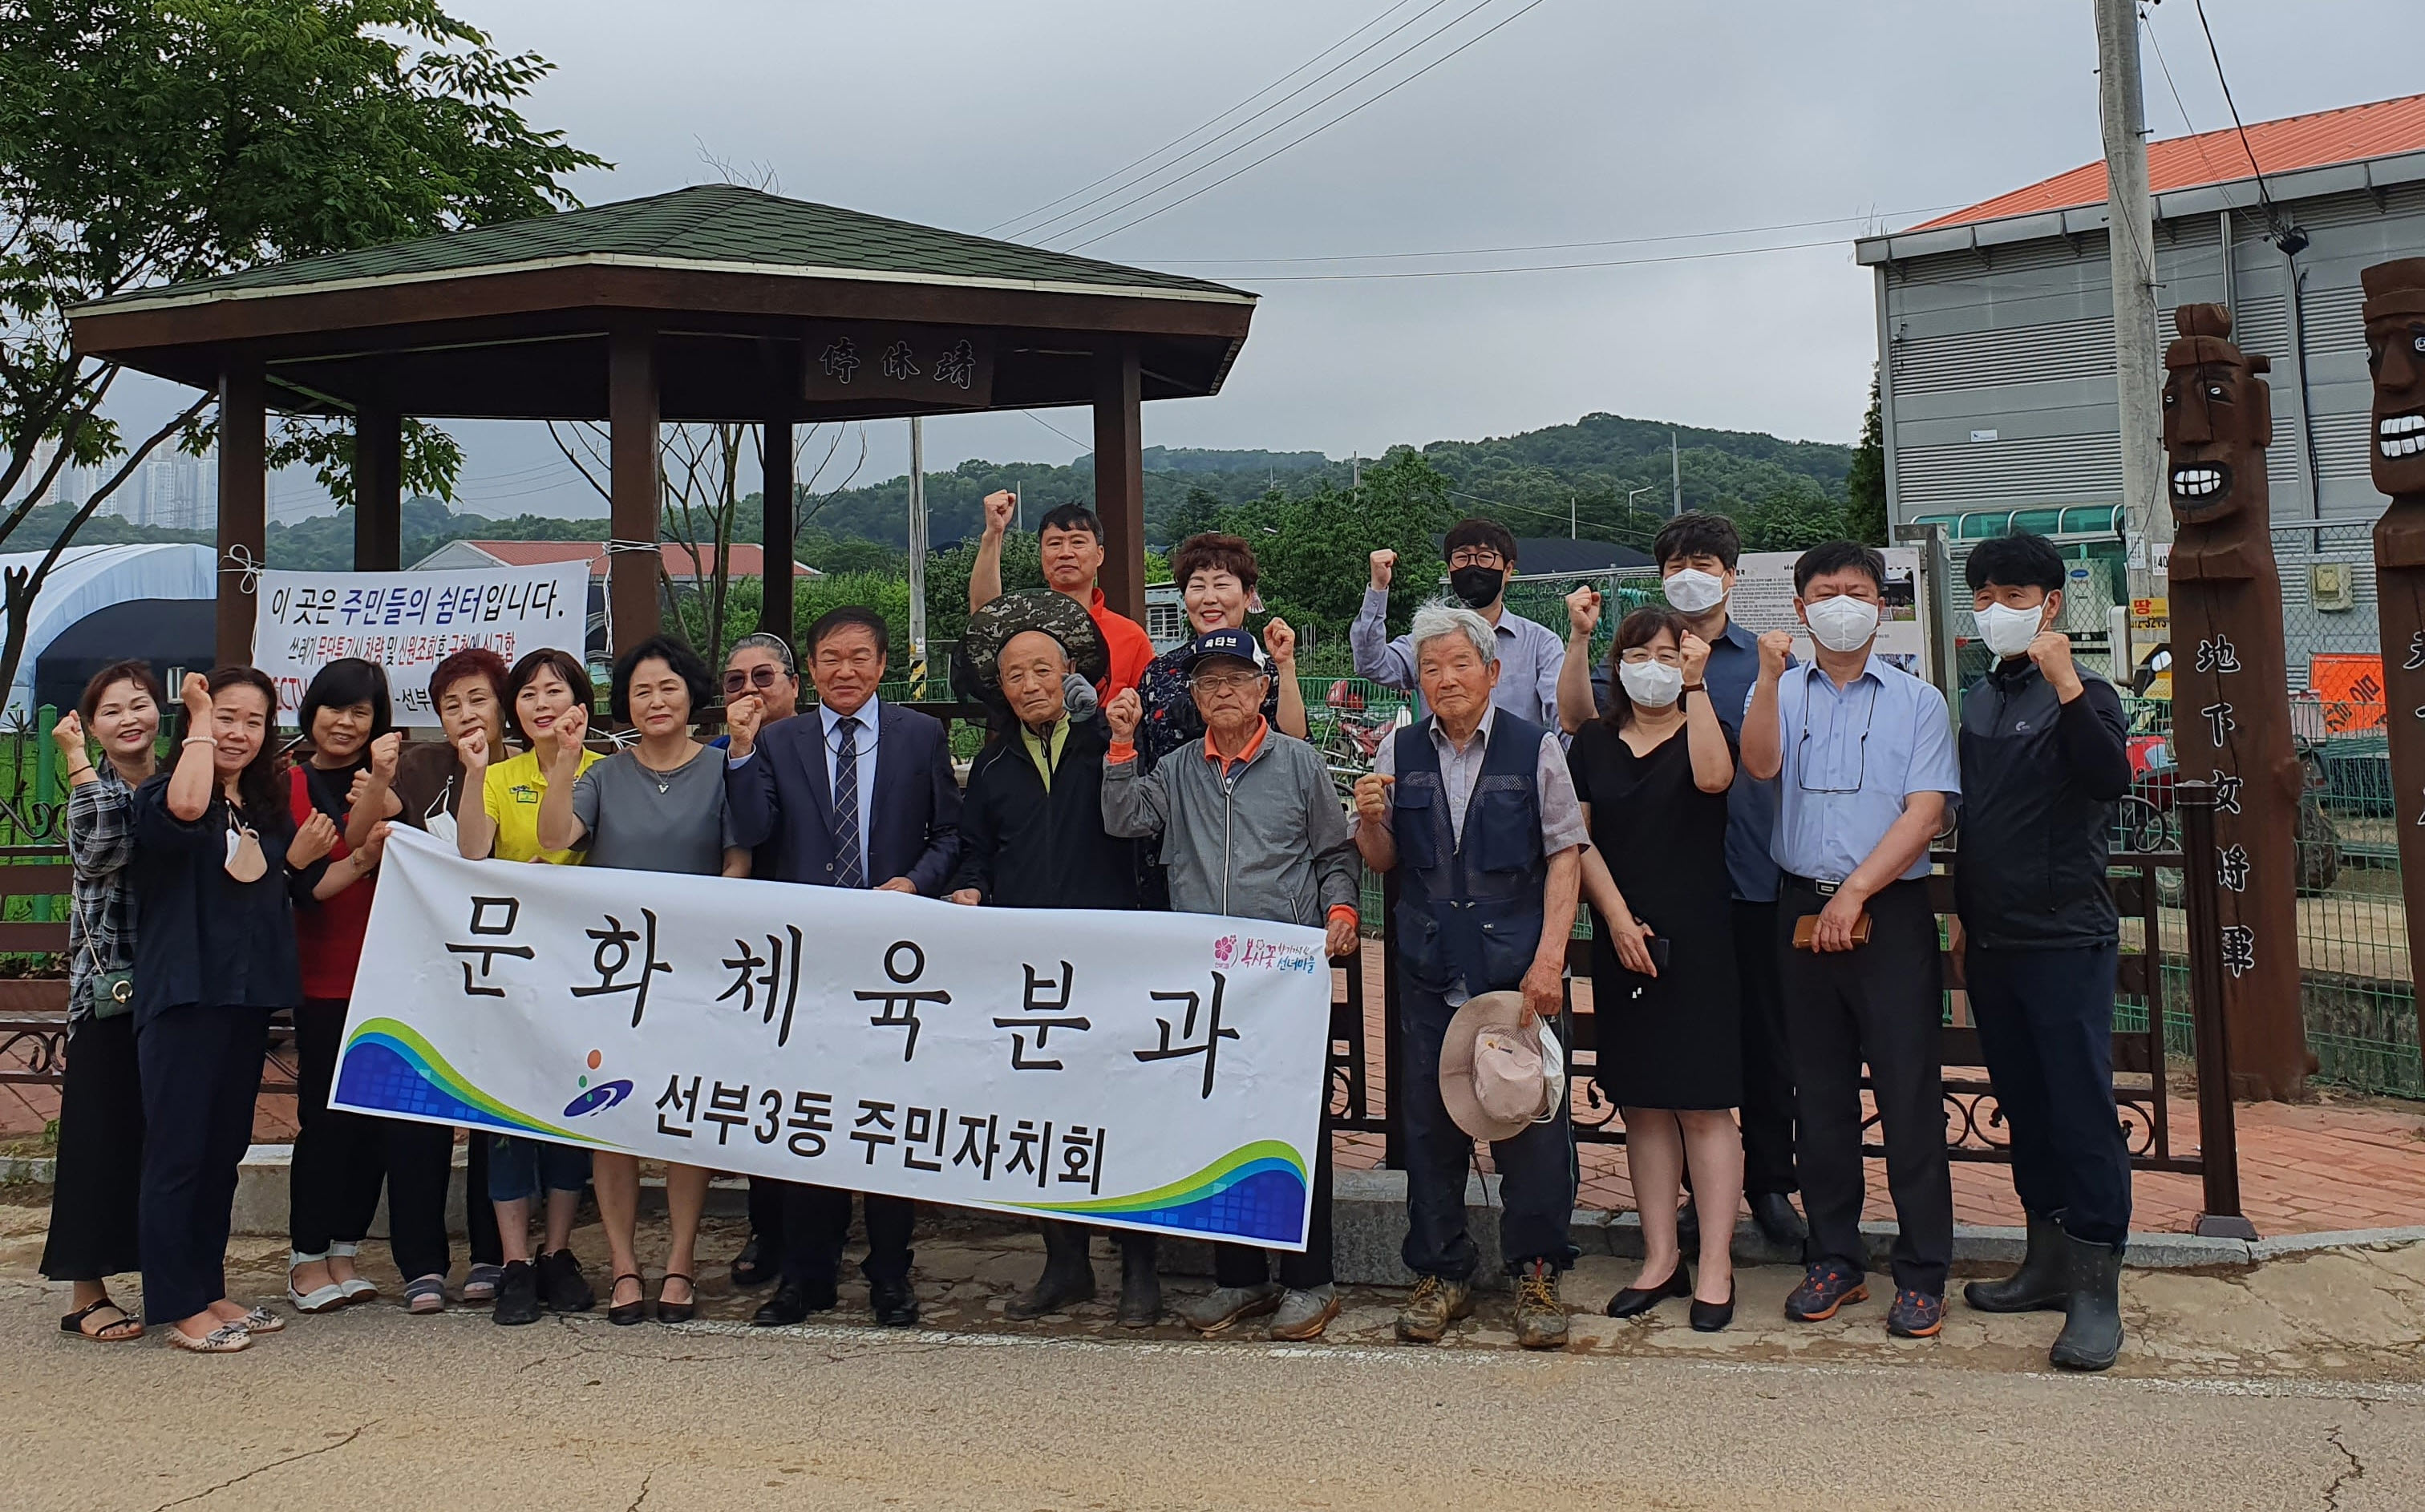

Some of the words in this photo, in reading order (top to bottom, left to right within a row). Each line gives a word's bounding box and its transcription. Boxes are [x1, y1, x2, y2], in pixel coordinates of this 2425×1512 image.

[272, 587, 291, 624] 이
[294, 588, 336, 625] 곳은
[340, 587, 431, 625] 주민들의
[435, 580, 564, 625] 쉼터입니다.
[288, 636, 318, 665] 쓰레기
[363, 636, 385, 665] 차량
[386, 636, 398, 665] 및
[399, 634, 447, 665] 신원조회후
[655, 1074, 832, 1157] 선부3동
[850, 1099, 1105, 1195] 주민자치회
